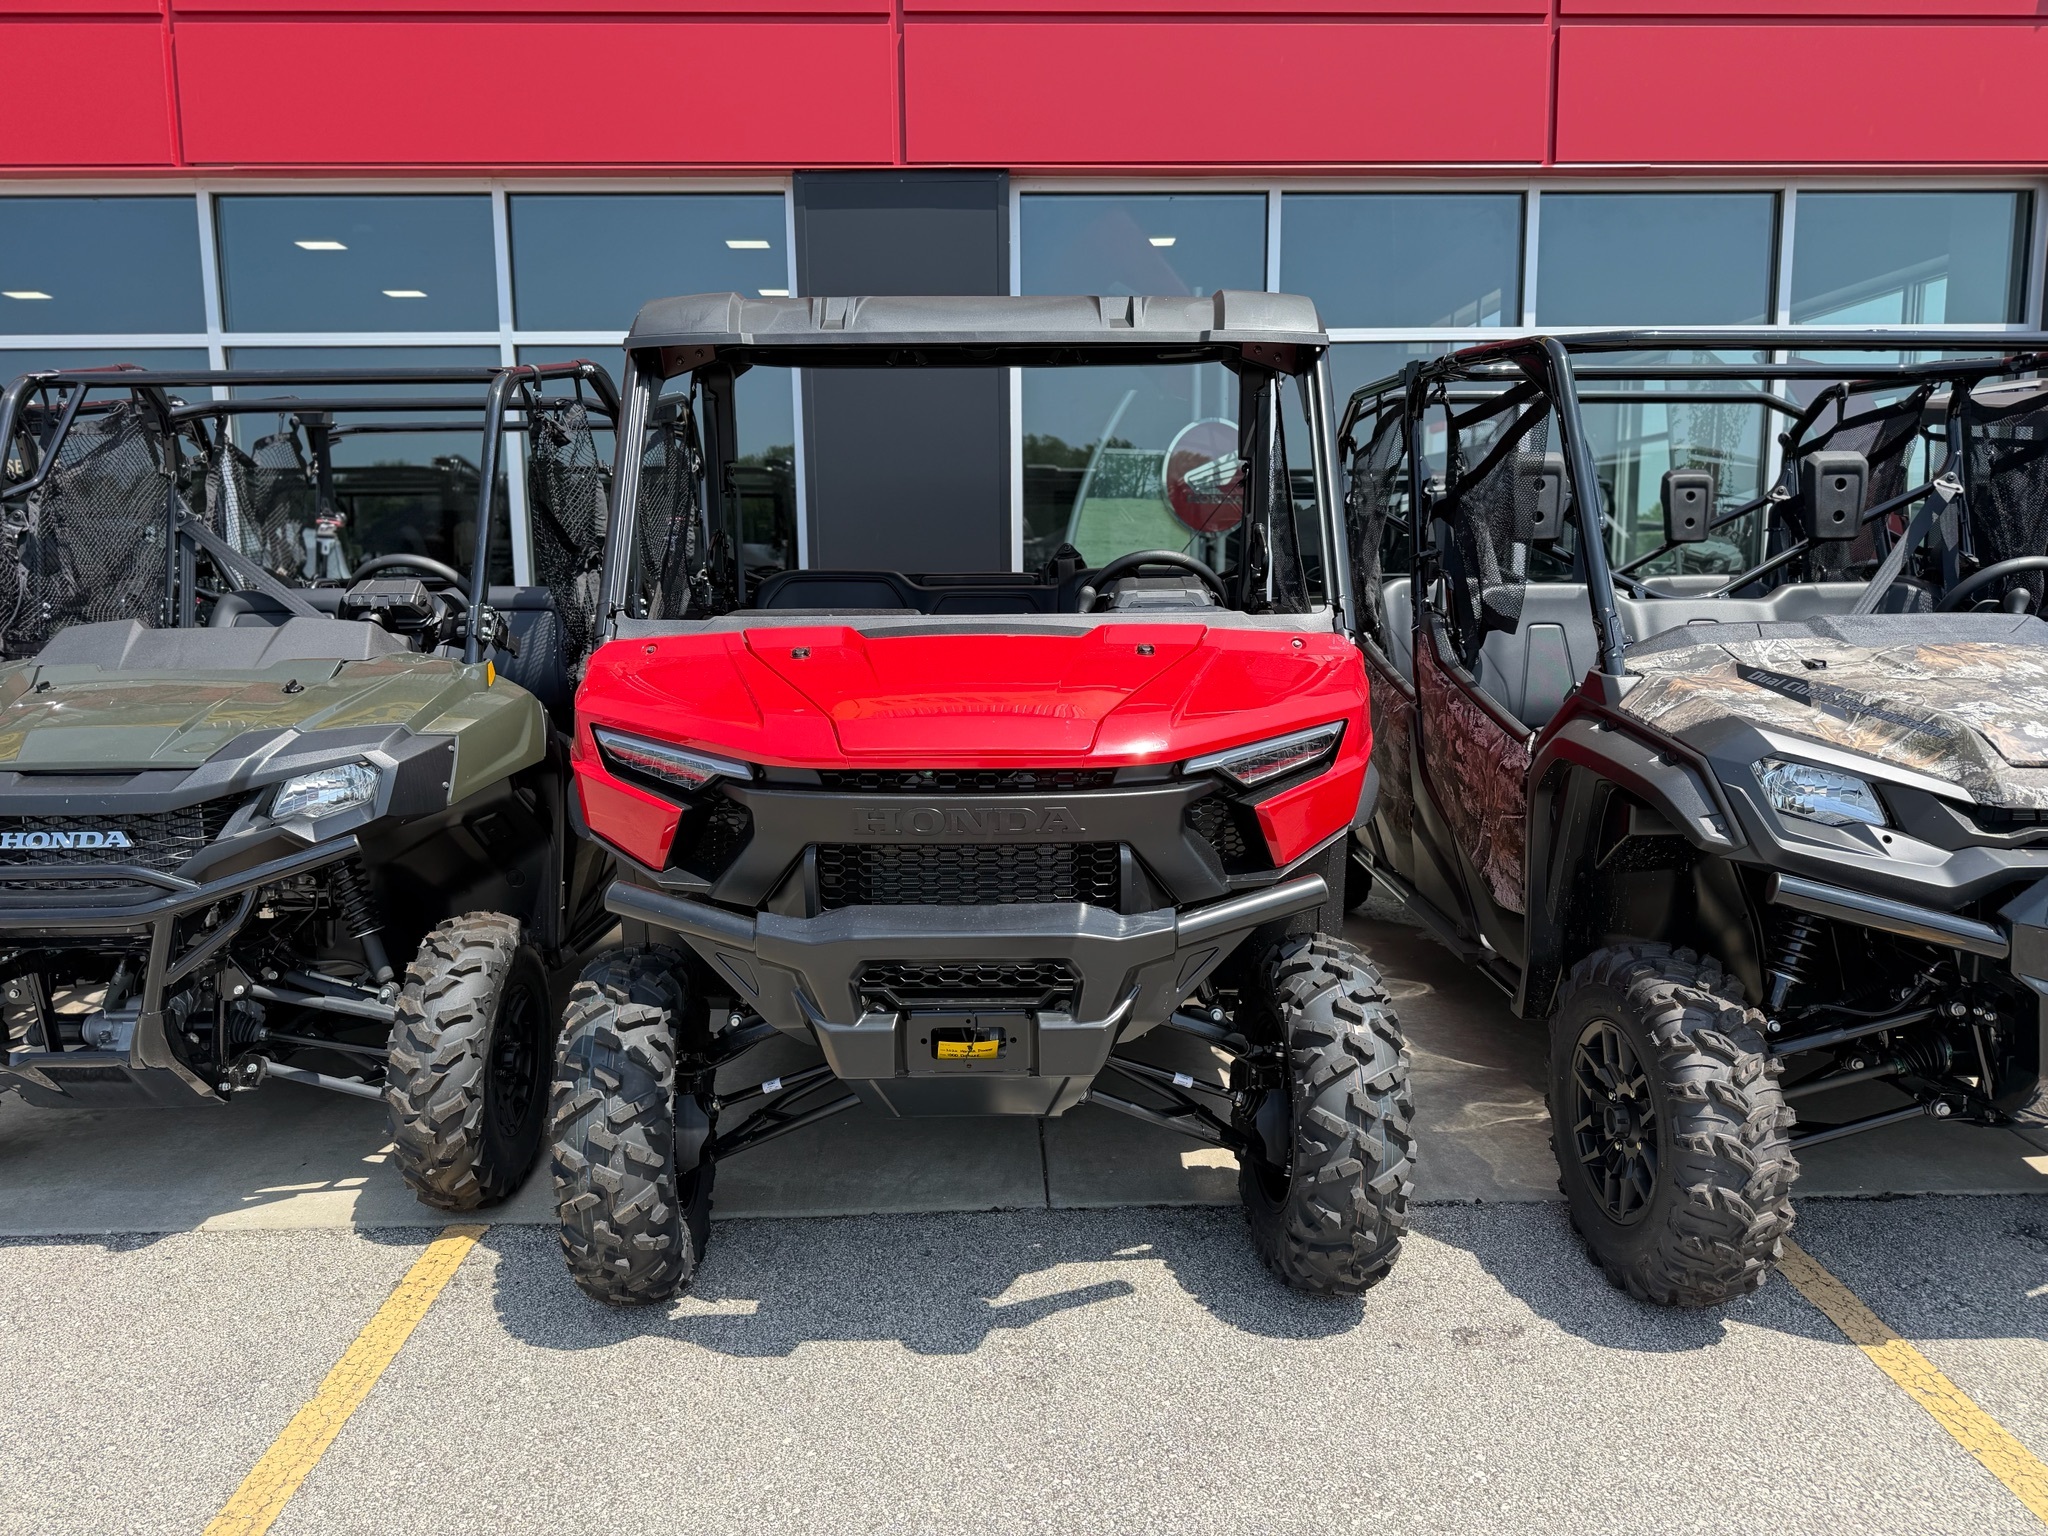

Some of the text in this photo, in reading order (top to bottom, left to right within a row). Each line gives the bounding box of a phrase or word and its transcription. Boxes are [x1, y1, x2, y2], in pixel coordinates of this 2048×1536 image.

[1748, 671, 1950, 738] Dual Clutch Transmission
[852, 807, 1086, 835] HONDA
[0, 831, 132, 849] HONDA
